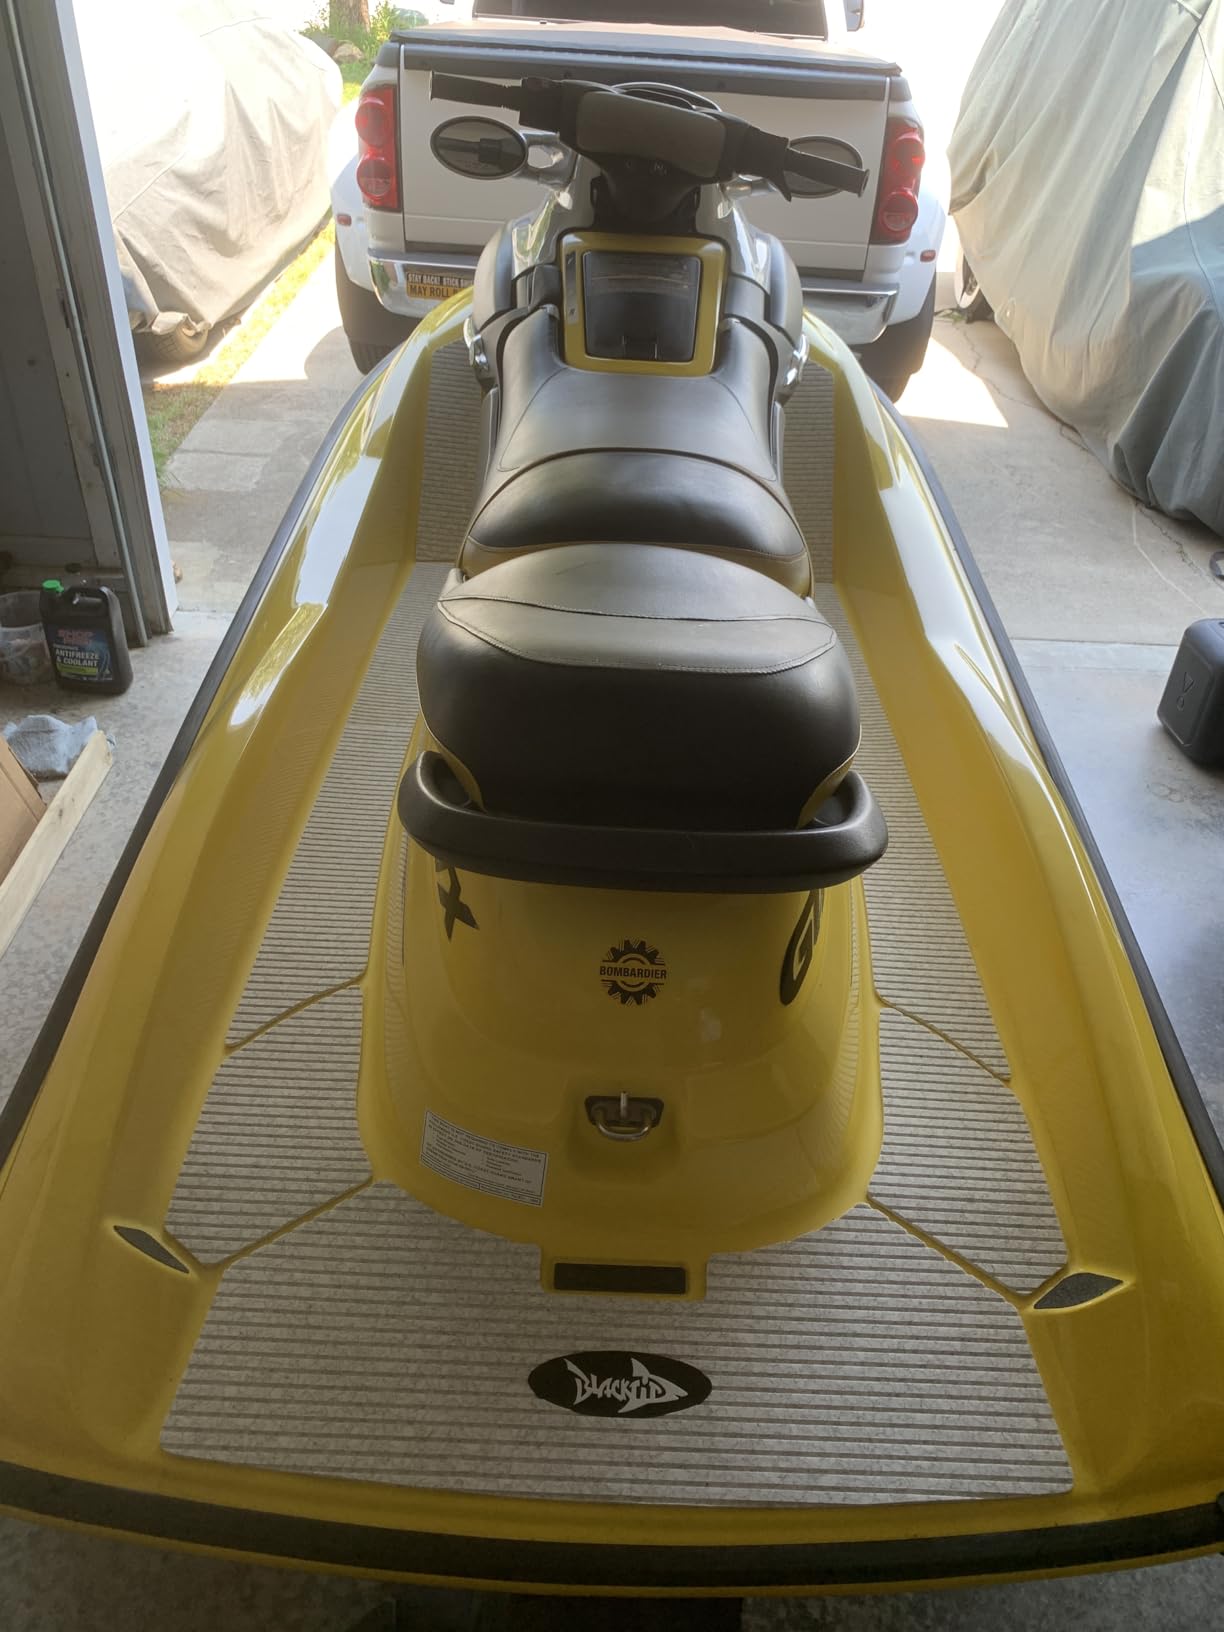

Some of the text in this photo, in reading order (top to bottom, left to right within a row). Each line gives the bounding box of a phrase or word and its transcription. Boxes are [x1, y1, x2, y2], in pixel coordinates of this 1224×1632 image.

[407, 273, 422, 283] STAY
[408, 284, 428, 296] MAY
[429, 286, 450, 297] ROLL
[55, 649, 100, 660] ANTIFREEZE
[63, 656, 99, 667] COOLANT
[599, 966, 667, 979] BOMBARDIER
